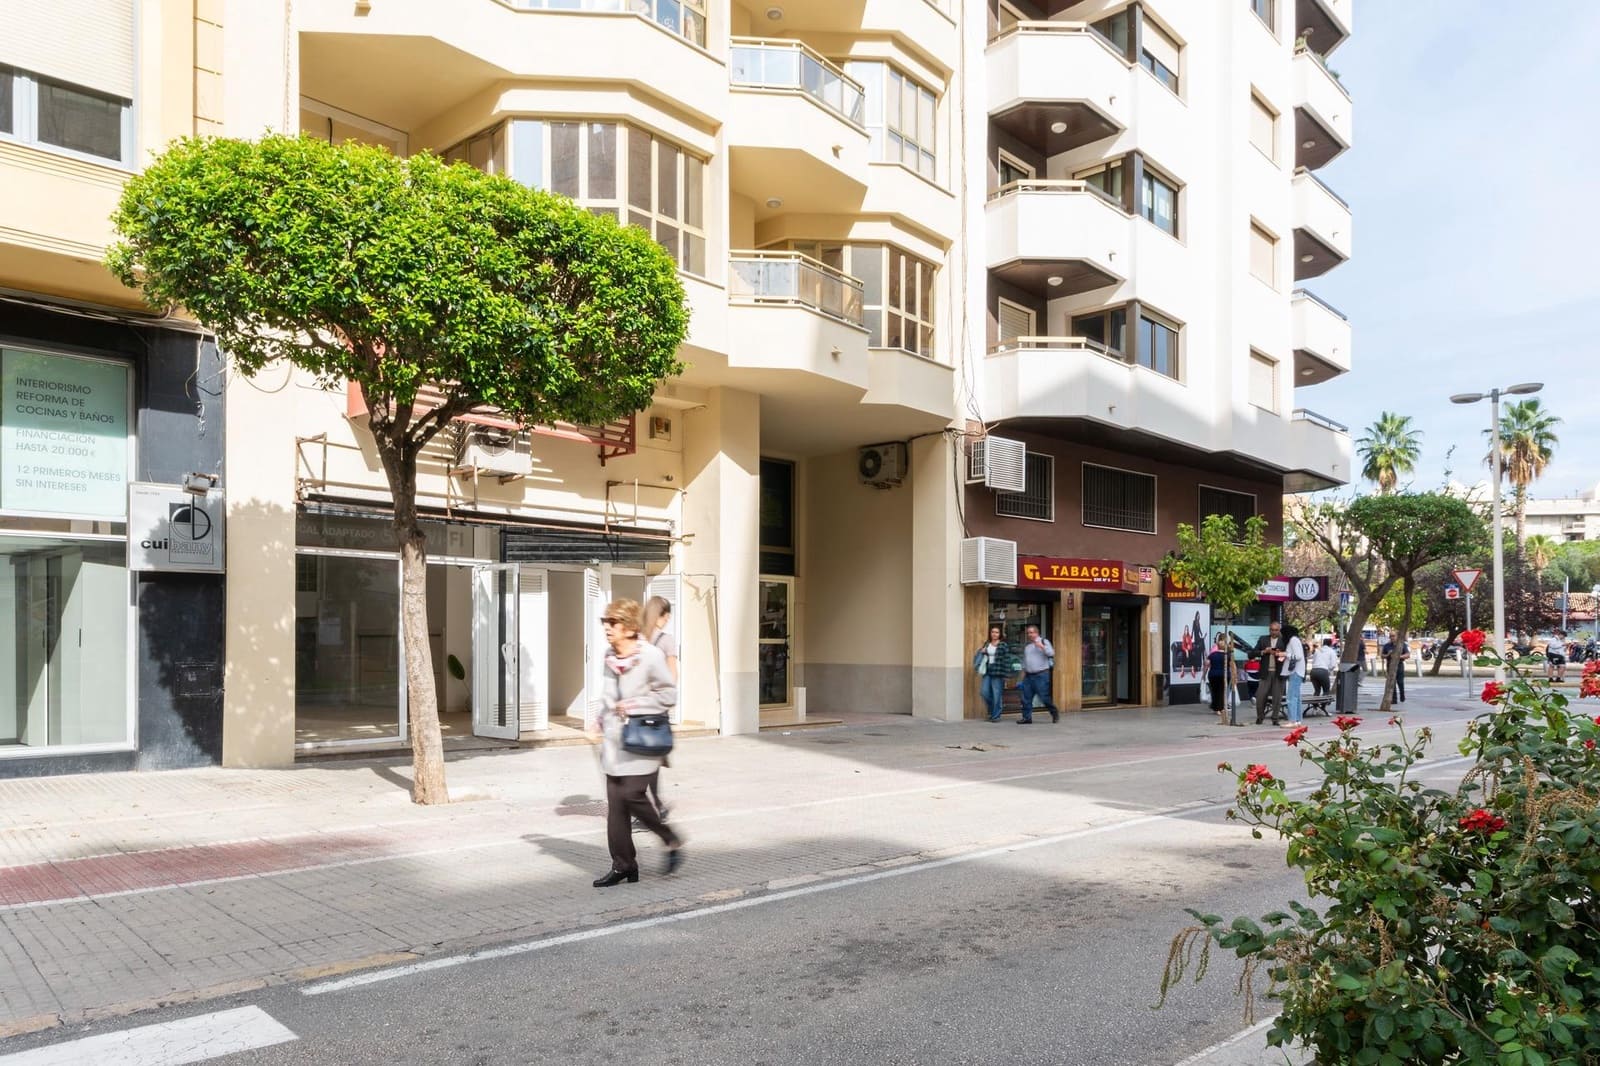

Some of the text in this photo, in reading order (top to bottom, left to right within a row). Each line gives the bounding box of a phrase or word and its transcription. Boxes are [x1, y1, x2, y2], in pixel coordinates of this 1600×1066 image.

[16, 377, 91, 395] INTERIORISMO
[16, 391, 85, 407] REFORMA DE
[16, 405, 68, 418] COCINAS
[70, 410, 77, 419] Y
[16, 442, 48, 453] HASTA
[17, 465, 121, 482] 12 PRIMEROS MESES
[16, 478, 87, 492] SIN INTERESES
[1051, 565, 1120, 578] TABACOS
[1298, 584, 1316, 594] NYA
